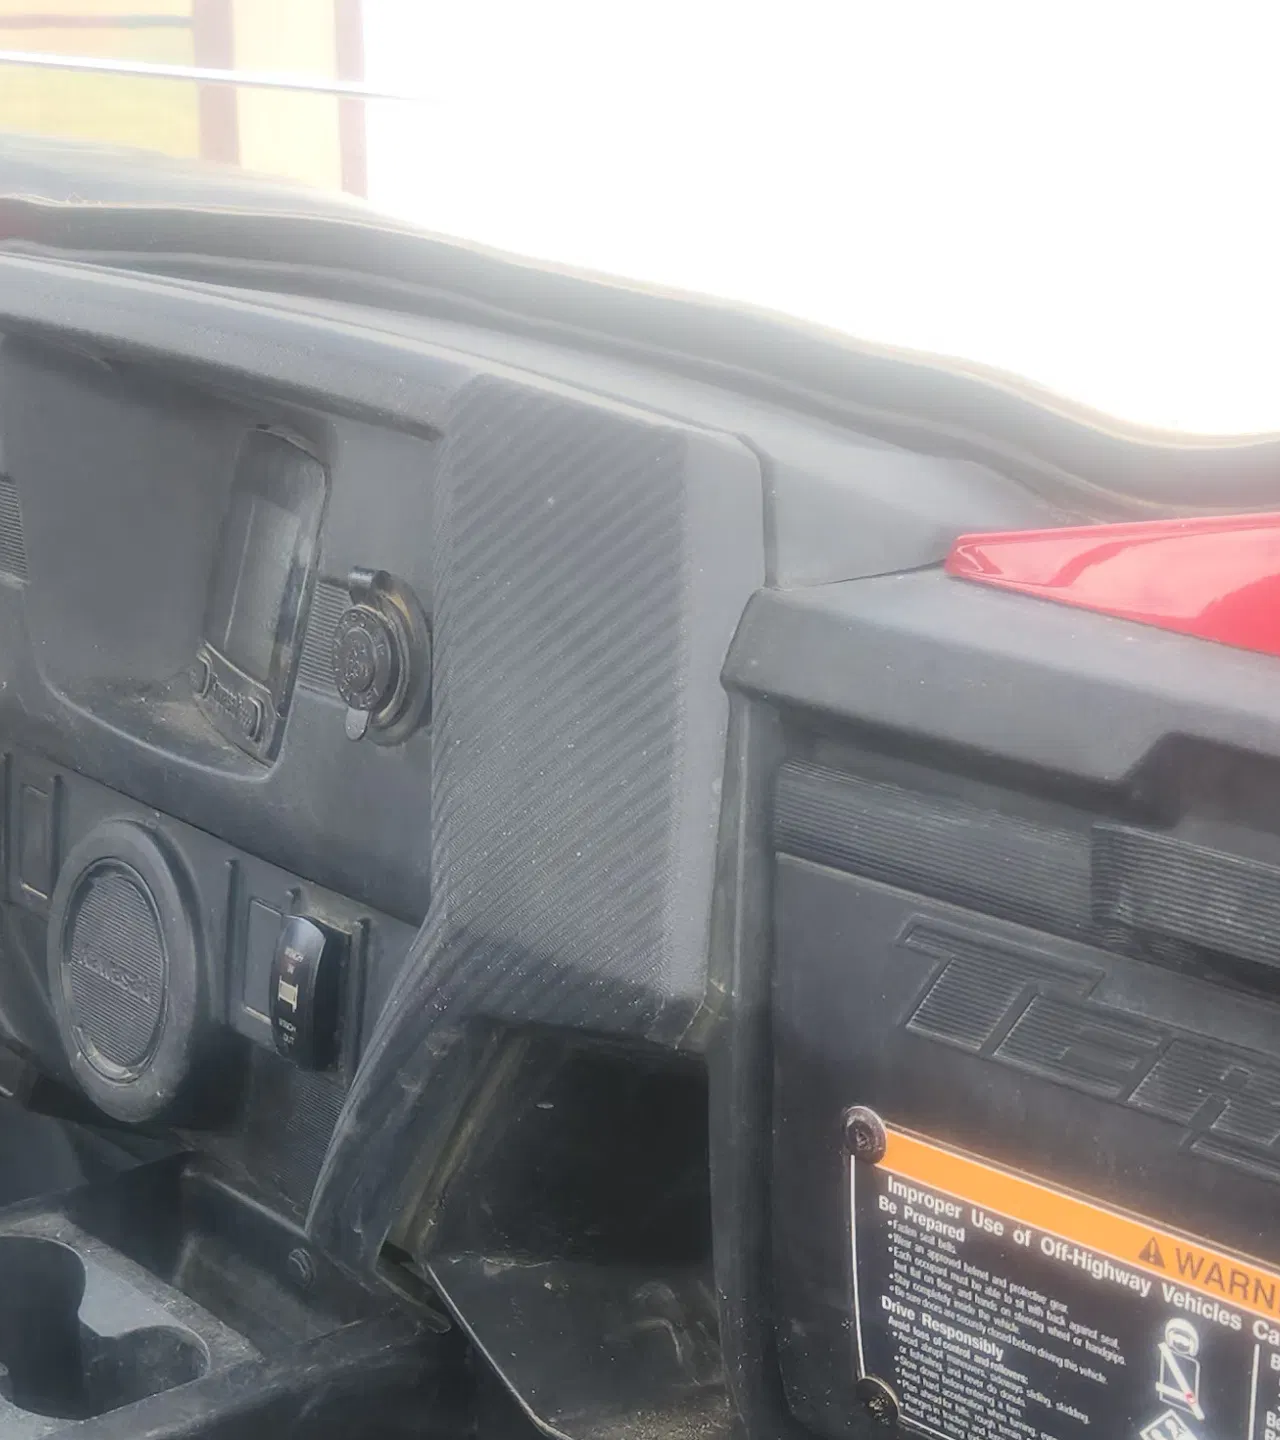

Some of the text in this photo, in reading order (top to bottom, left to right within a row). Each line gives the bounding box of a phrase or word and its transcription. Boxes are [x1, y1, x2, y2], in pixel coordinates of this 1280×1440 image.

[878, 1195, 964, 1241] Be Prepared
[888, 1176, 961, 1217] Improper
[971, 1208, 1003, 1235] Use
[1013, 1229, 1031, 1246] of
[1041, 1237, 1150, 1296] Off-Highway
[1162, 1283, 1241, 1329] Vehicles
[881, 1295, 1003, 1360] Drive Responsibly
